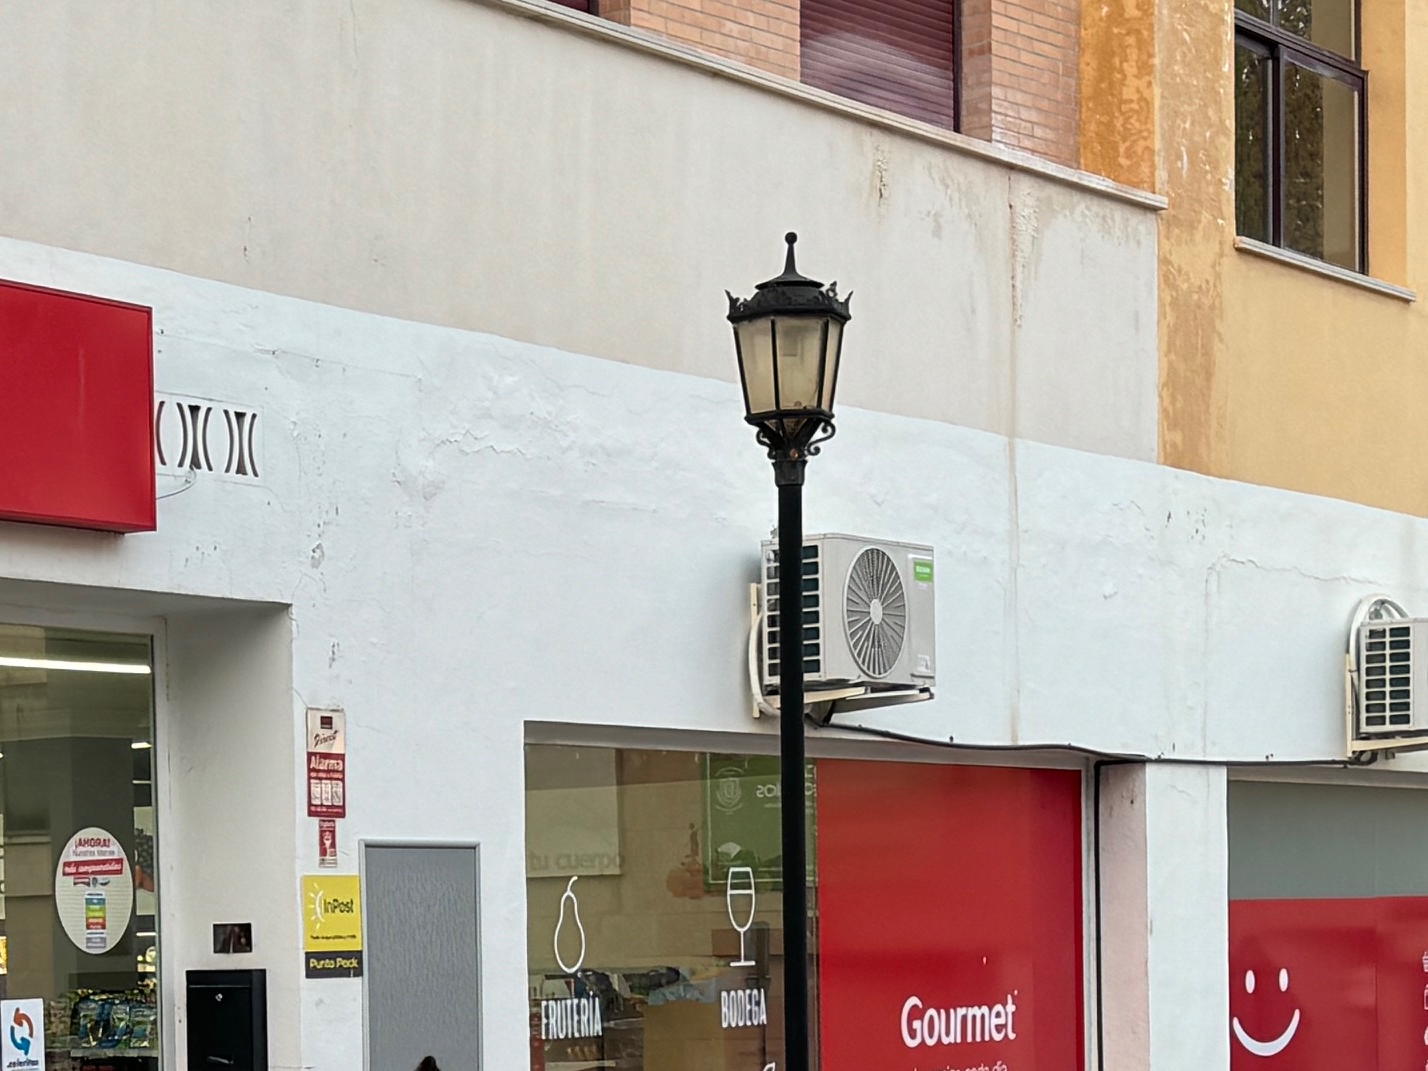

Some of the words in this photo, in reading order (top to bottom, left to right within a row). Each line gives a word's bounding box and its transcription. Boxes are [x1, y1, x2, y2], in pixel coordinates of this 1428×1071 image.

[324, 898, 354, 914] InPost
[541, 991, 602, 1040] FRUTERÍA
[721, 988, 767, 1029] BODEGA
[901, 993, 1017, 1048] Gourmet
